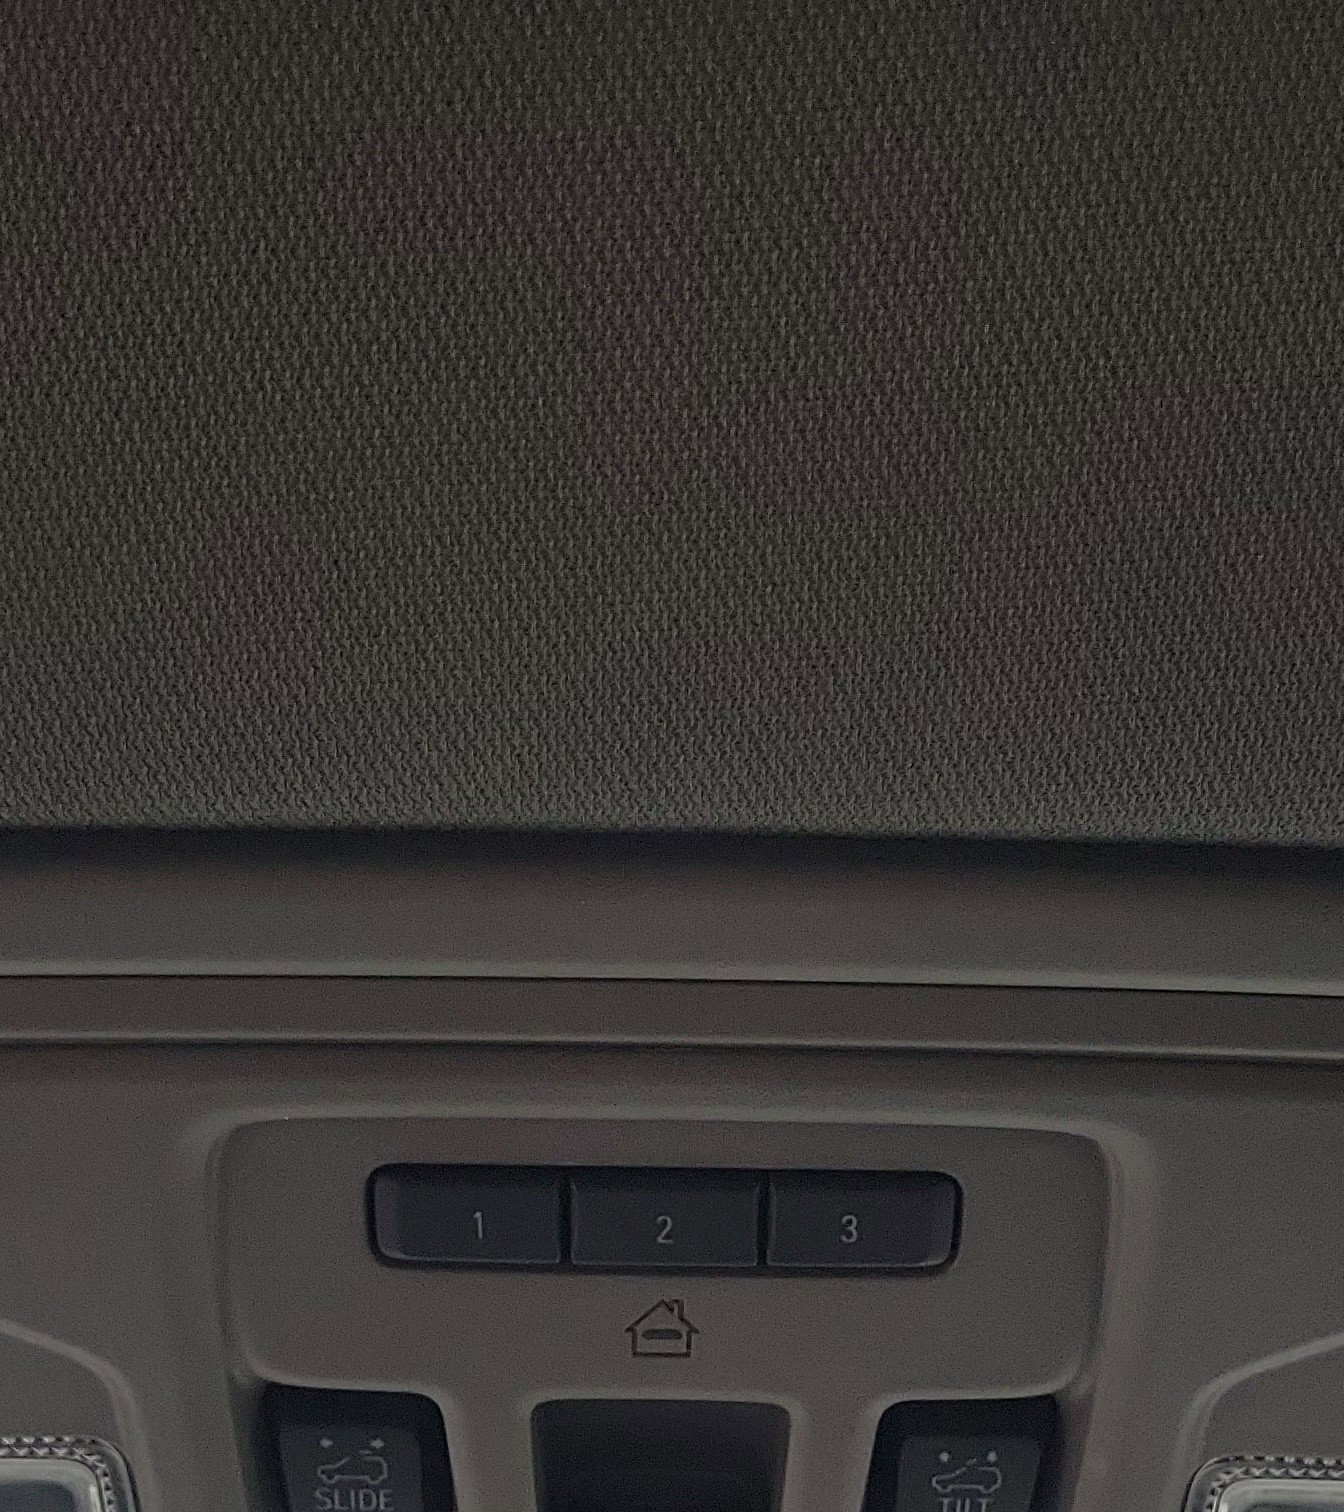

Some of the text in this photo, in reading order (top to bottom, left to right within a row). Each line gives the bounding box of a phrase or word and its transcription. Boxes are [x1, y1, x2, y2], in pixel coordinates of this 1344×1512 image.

[472, 1210, 485, 1240] 1
[656, 1216, 674, 1245] 2
[839, 1215, 858, 1243] 3
[314, 1488, 394, 1512] SLIDE
